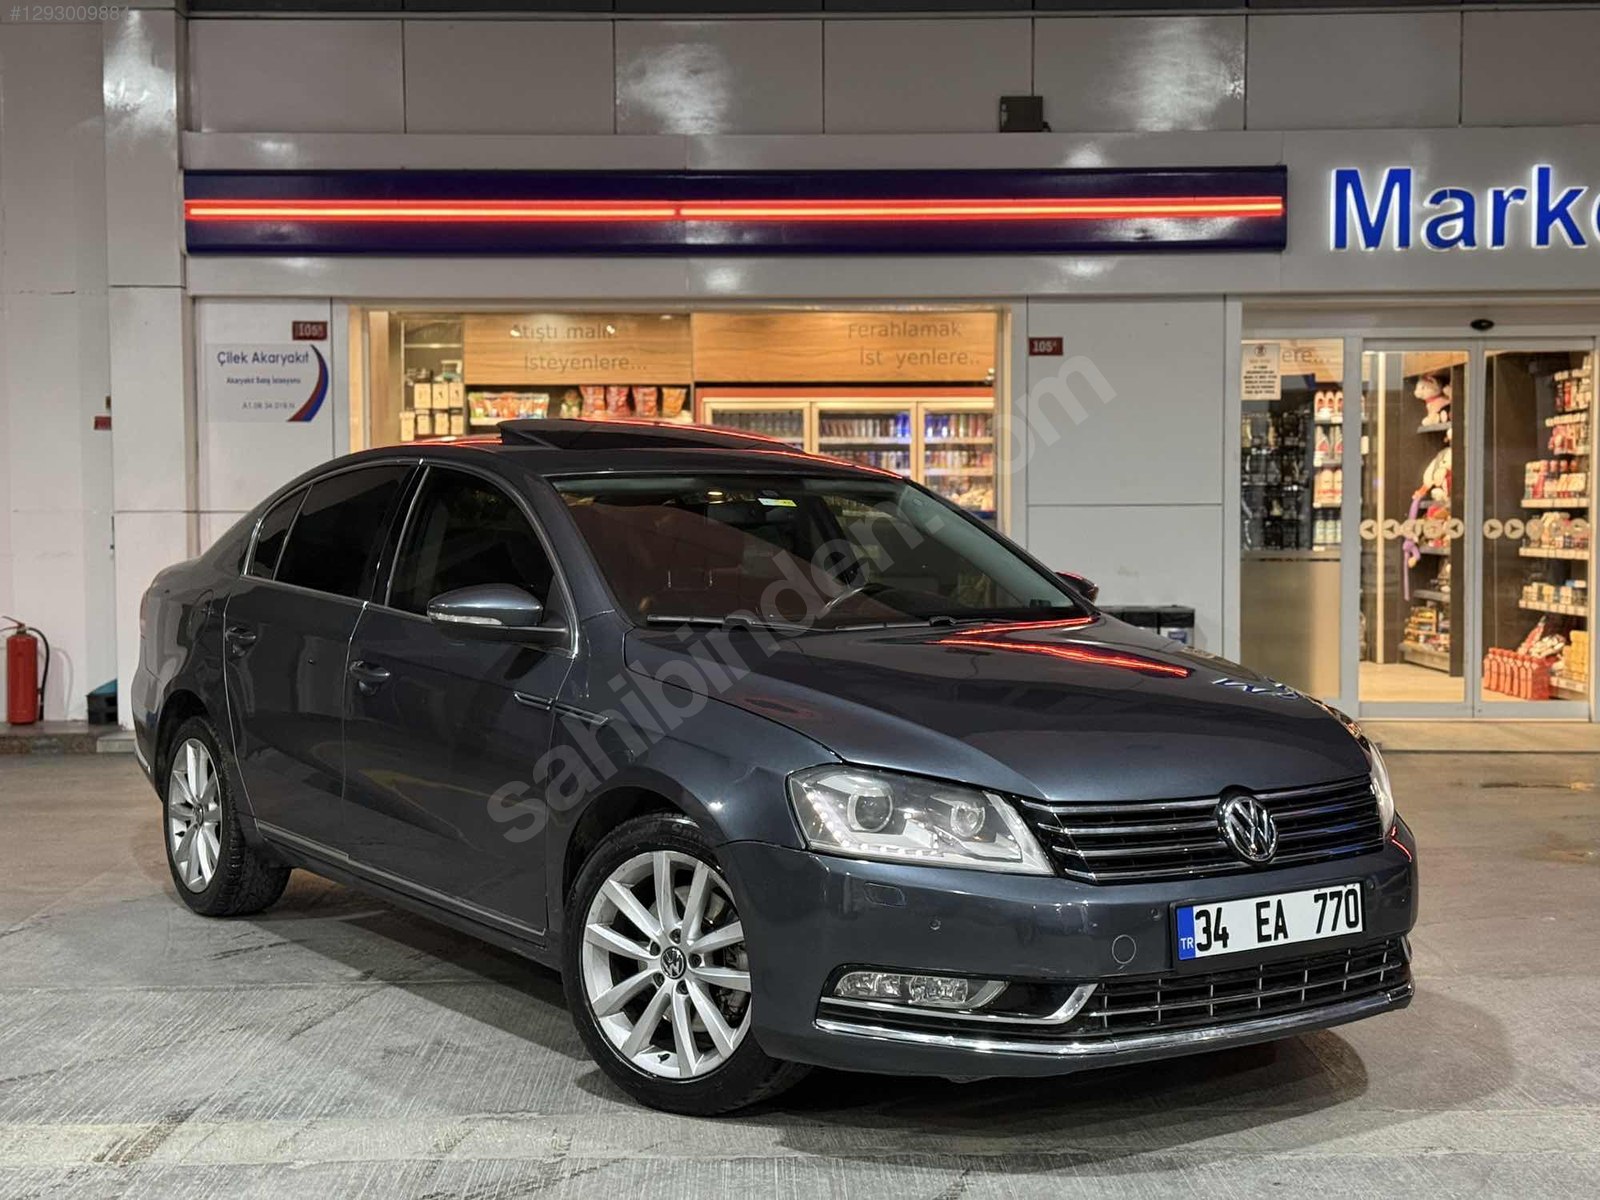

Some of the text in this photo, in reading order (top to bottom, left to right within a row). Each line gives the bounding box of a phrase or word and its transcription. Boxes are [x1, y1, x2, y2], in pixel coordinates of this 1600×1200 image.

[1330, 164, 1600, 251] Mark
[217, 351, 309, 366] Çilek Akaryakıt
[1195, 888, 1360, 952] 34 EA 770
[1180, 937, 1194, 950] TR
